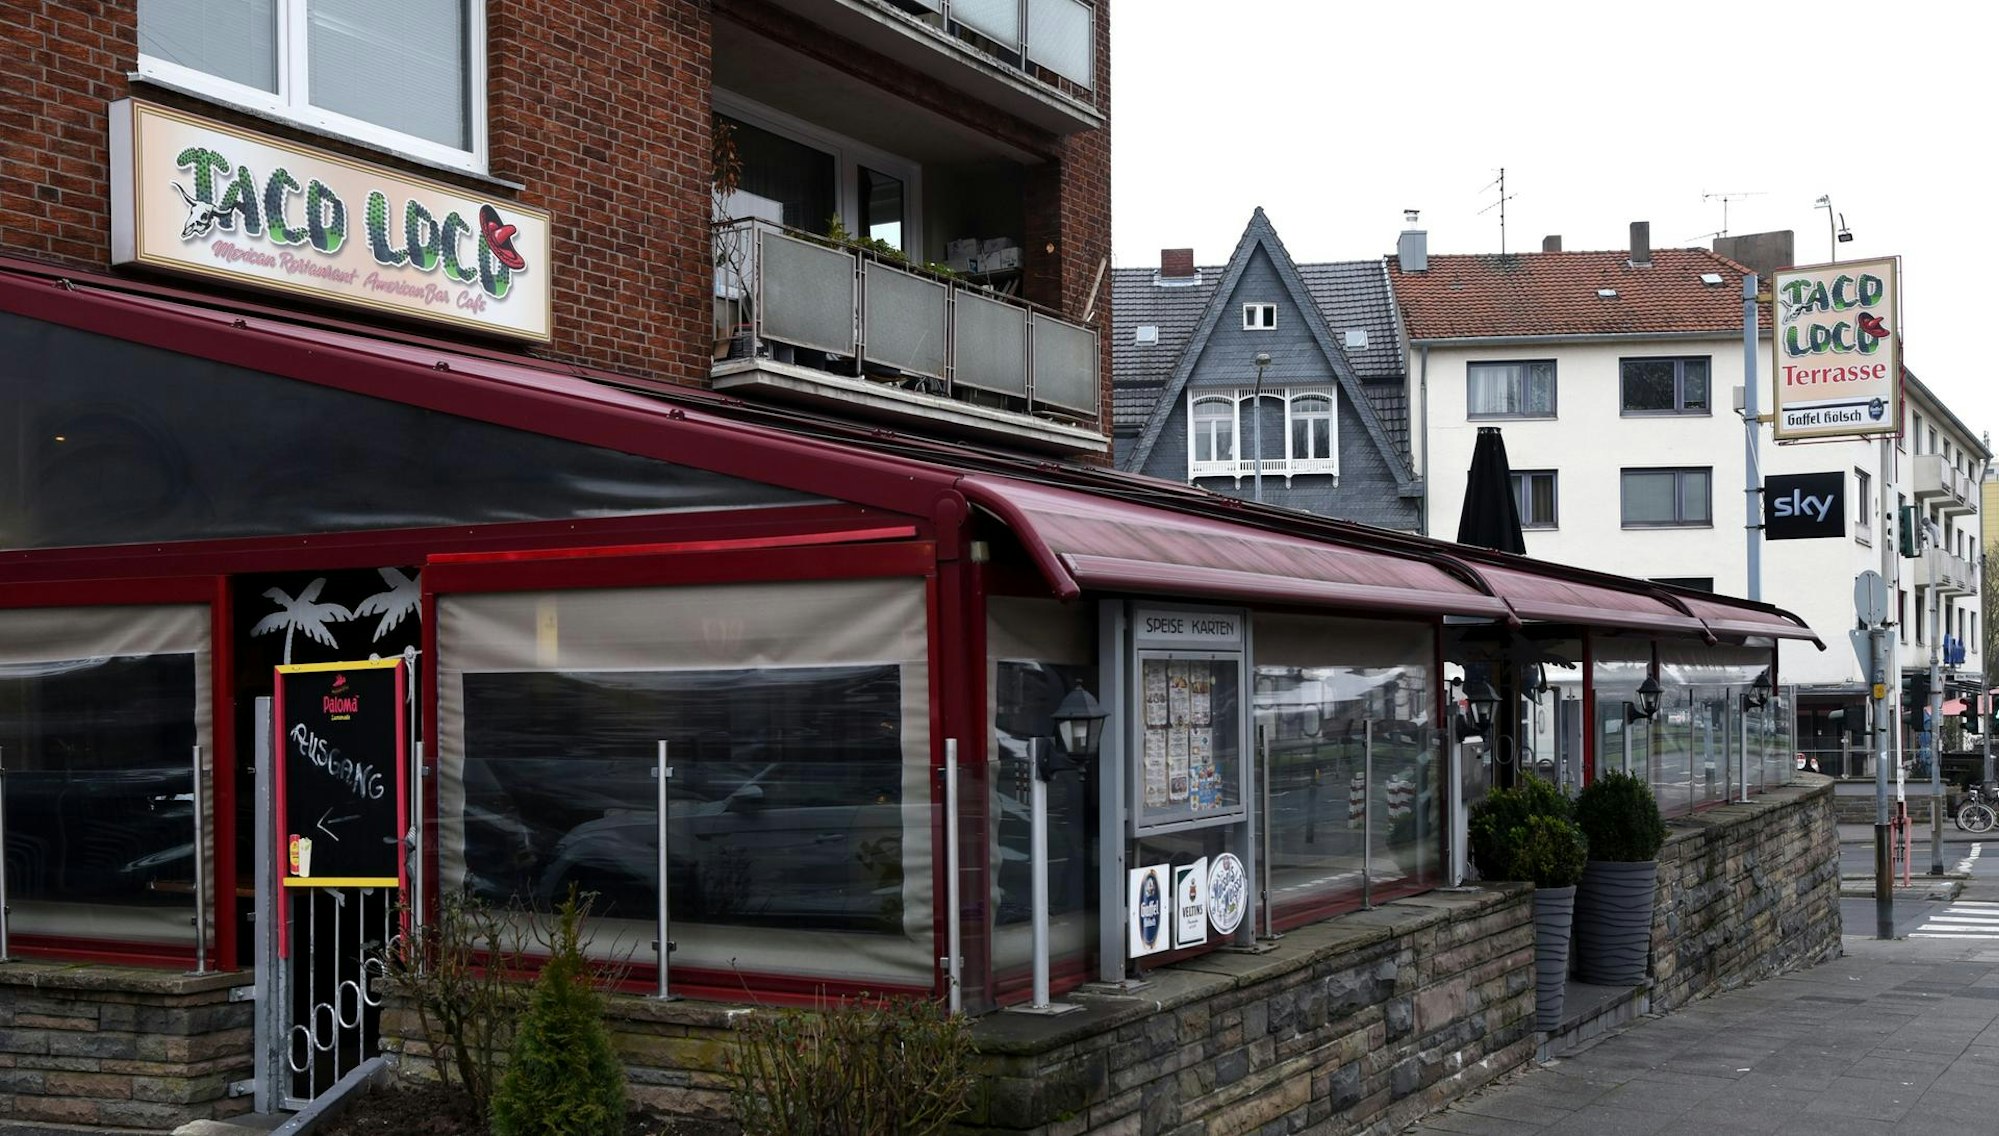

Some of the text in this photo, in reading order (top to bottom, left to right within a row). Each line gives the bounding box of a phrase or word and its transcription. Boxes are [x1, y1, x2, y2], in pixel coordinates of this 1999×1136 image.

[176, 147, 513, 299] TACO LOCO
[211, 240, 277, 264] Mexican
[279, 252, 359, 285] Restaurant
[1781, 273, 1884, 357] TACO LOCO
[1782, 362, 1886, 386] Terrasse
[1787, 411, 1821, 426] Gaffel
[1824, 409, 1861, 424] Kölsch
[1774, 488, 1835, 523] sky
[1146, 617, 1235, 636] SPEISE KARTEN
[323, 695, 358, 714] Paloma
[1182, 904, 1203, 918] VELTINS
